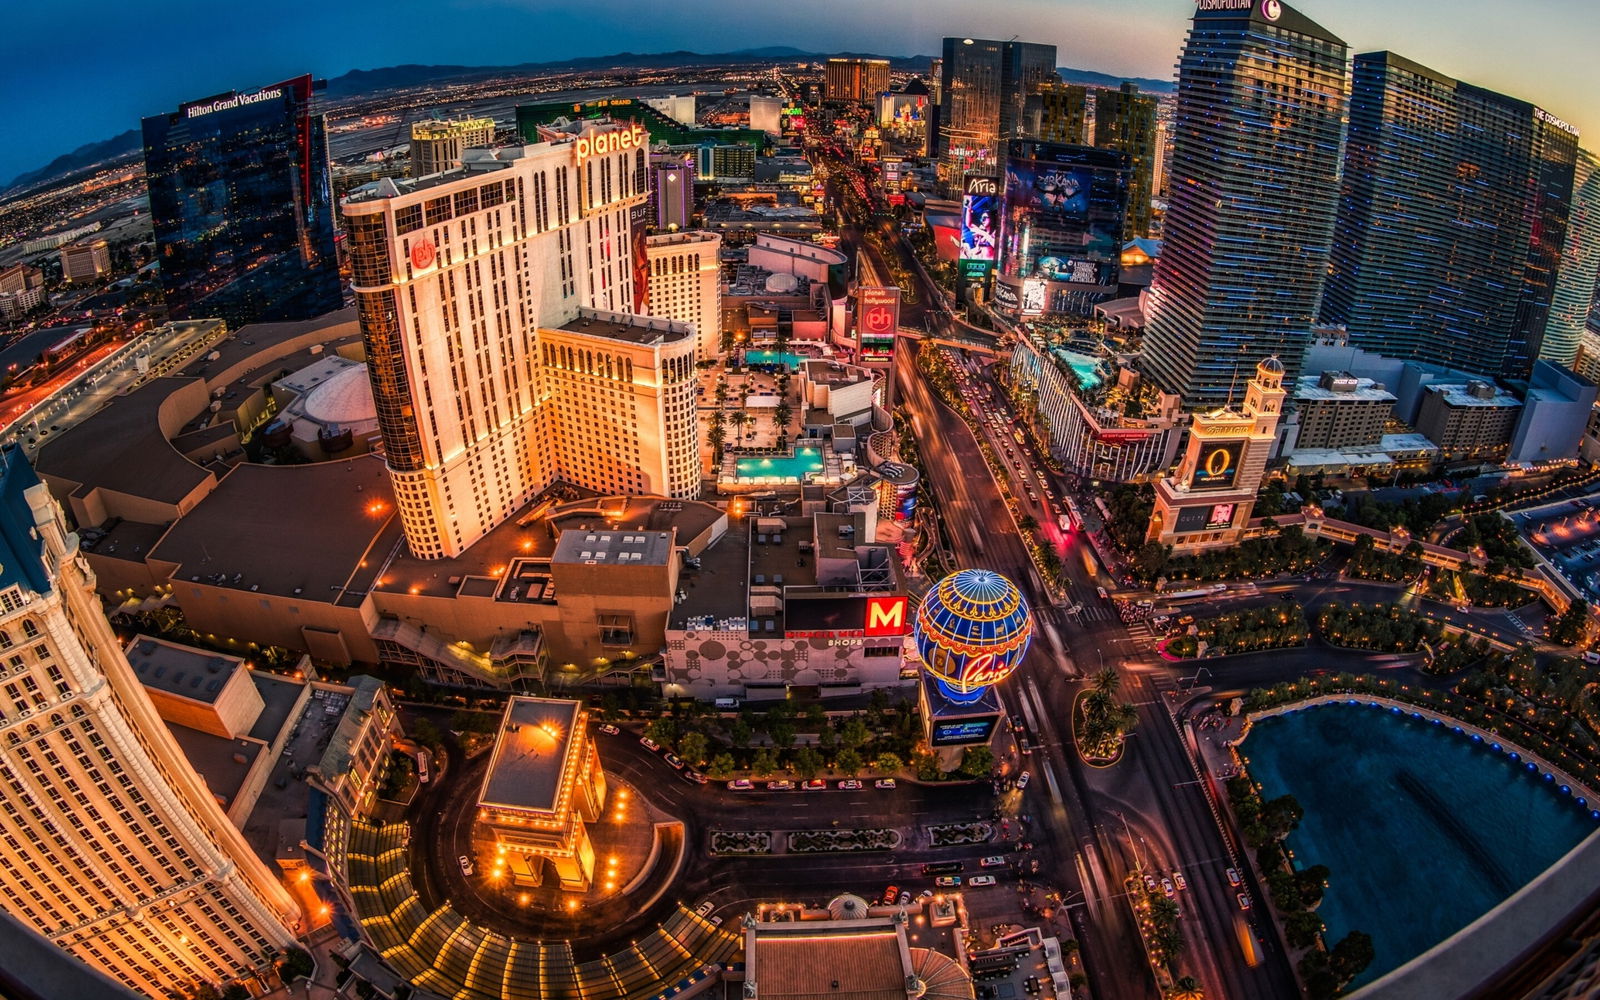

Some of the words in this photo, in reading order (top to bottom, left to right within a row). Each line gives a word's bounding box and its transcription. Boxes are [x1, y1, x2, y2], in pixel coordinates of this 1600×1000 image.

[1198, 0, 1251, 10] COSMOPOLITAN
[188, 105, 213, 118] Hilton
[213, 96, 238, 112] Grand
[239, 88, 281, 106] Vacations
[1534, 107, 1545, 120] THE
[1545, 113, 1580, 137] COSMOPOLITAN
[577, 124, 642, 167] planet
[968, 178, 996, 193] Aria
[869, 601, 903, 628] M
[961, 653, 1010, 693] Paris
